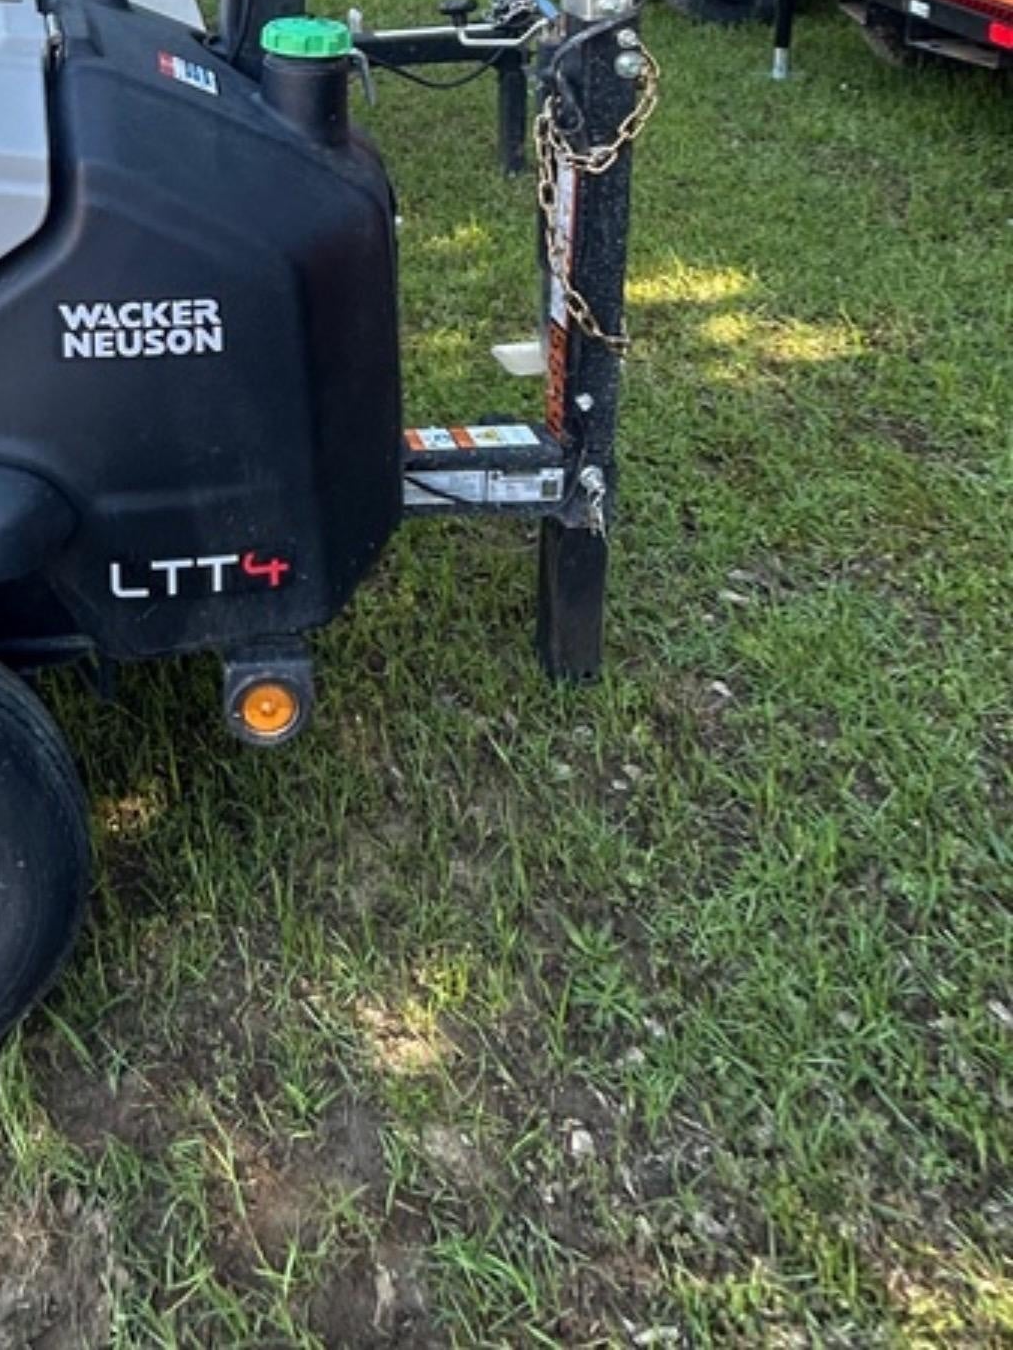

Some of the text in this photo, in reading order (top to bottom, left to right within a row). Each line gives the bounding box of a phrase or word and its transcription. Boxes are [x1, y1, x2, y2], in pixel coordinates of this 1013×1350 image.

[58, 298, 222, 331] WACKER
[63, 326, 223, 358] NEUSON
[109, 552, 290, 599] LTT4
